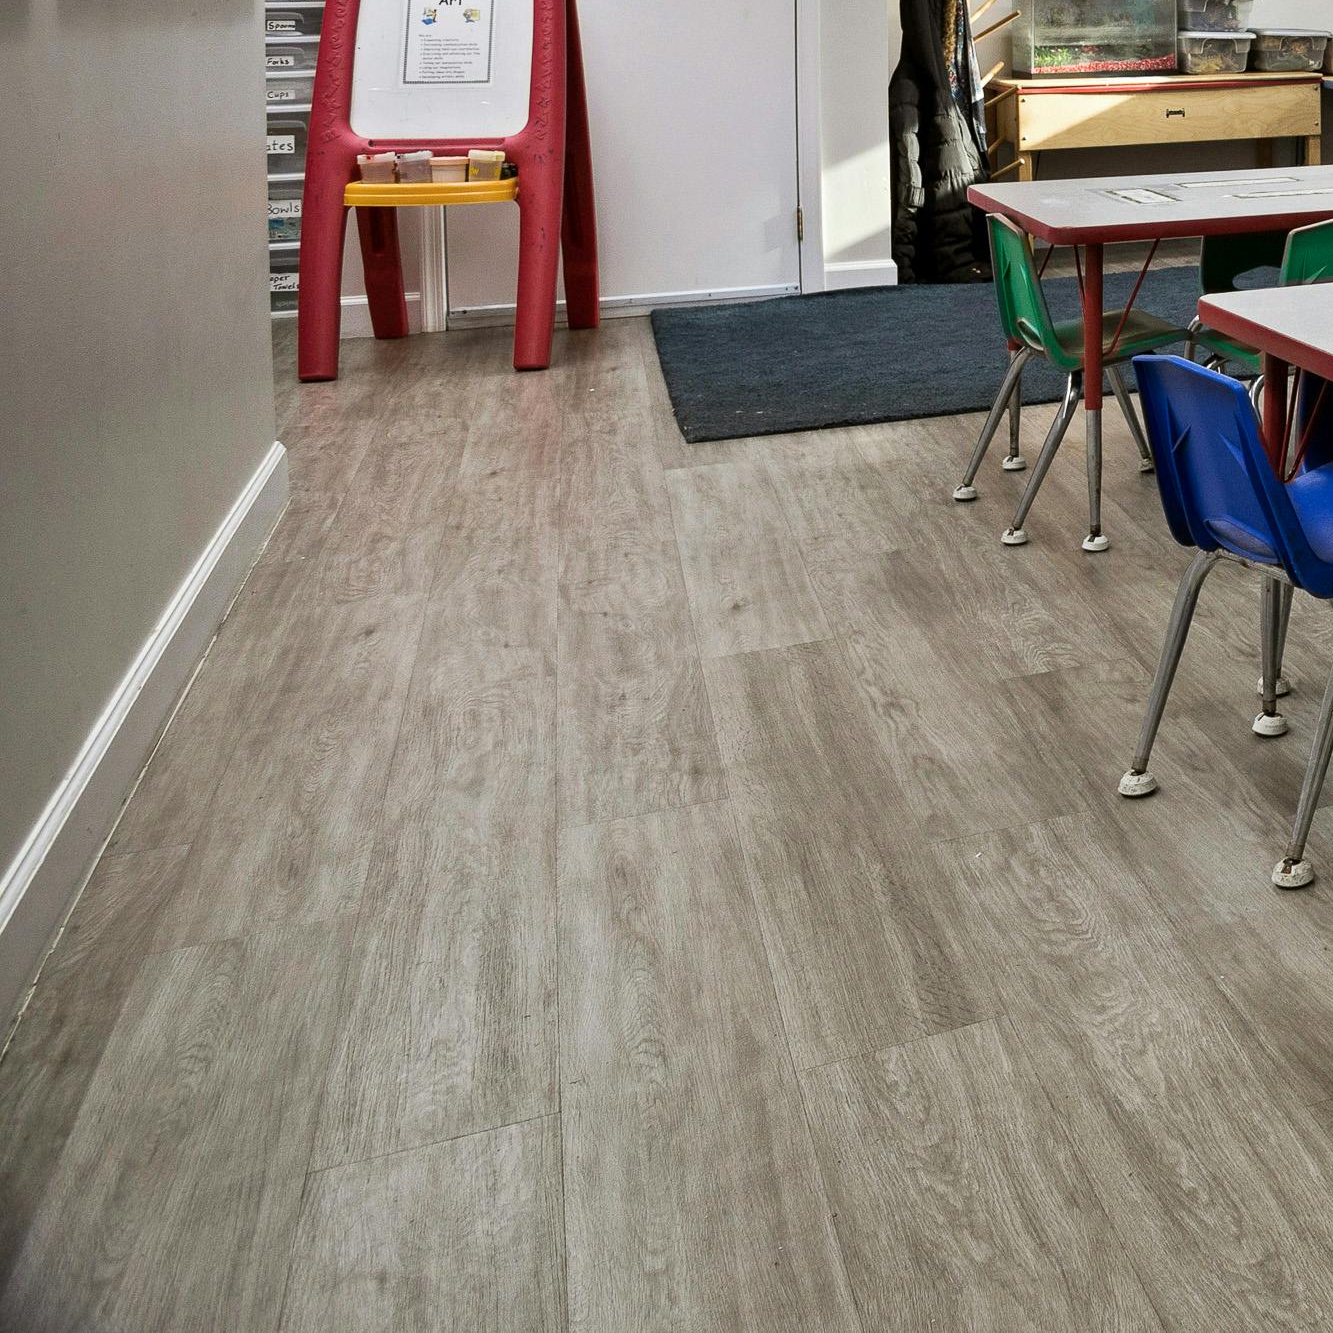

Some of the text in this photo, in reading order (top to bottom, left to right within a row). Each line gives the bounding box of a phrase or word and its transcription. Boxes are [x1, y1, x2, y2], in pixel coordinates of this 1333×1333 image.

[266, 57, 290, 66] Forks
[267, 90, 289, 99] Cups
[266, 140, 294, 151] ates
[270, 274, 290, 283] aper
